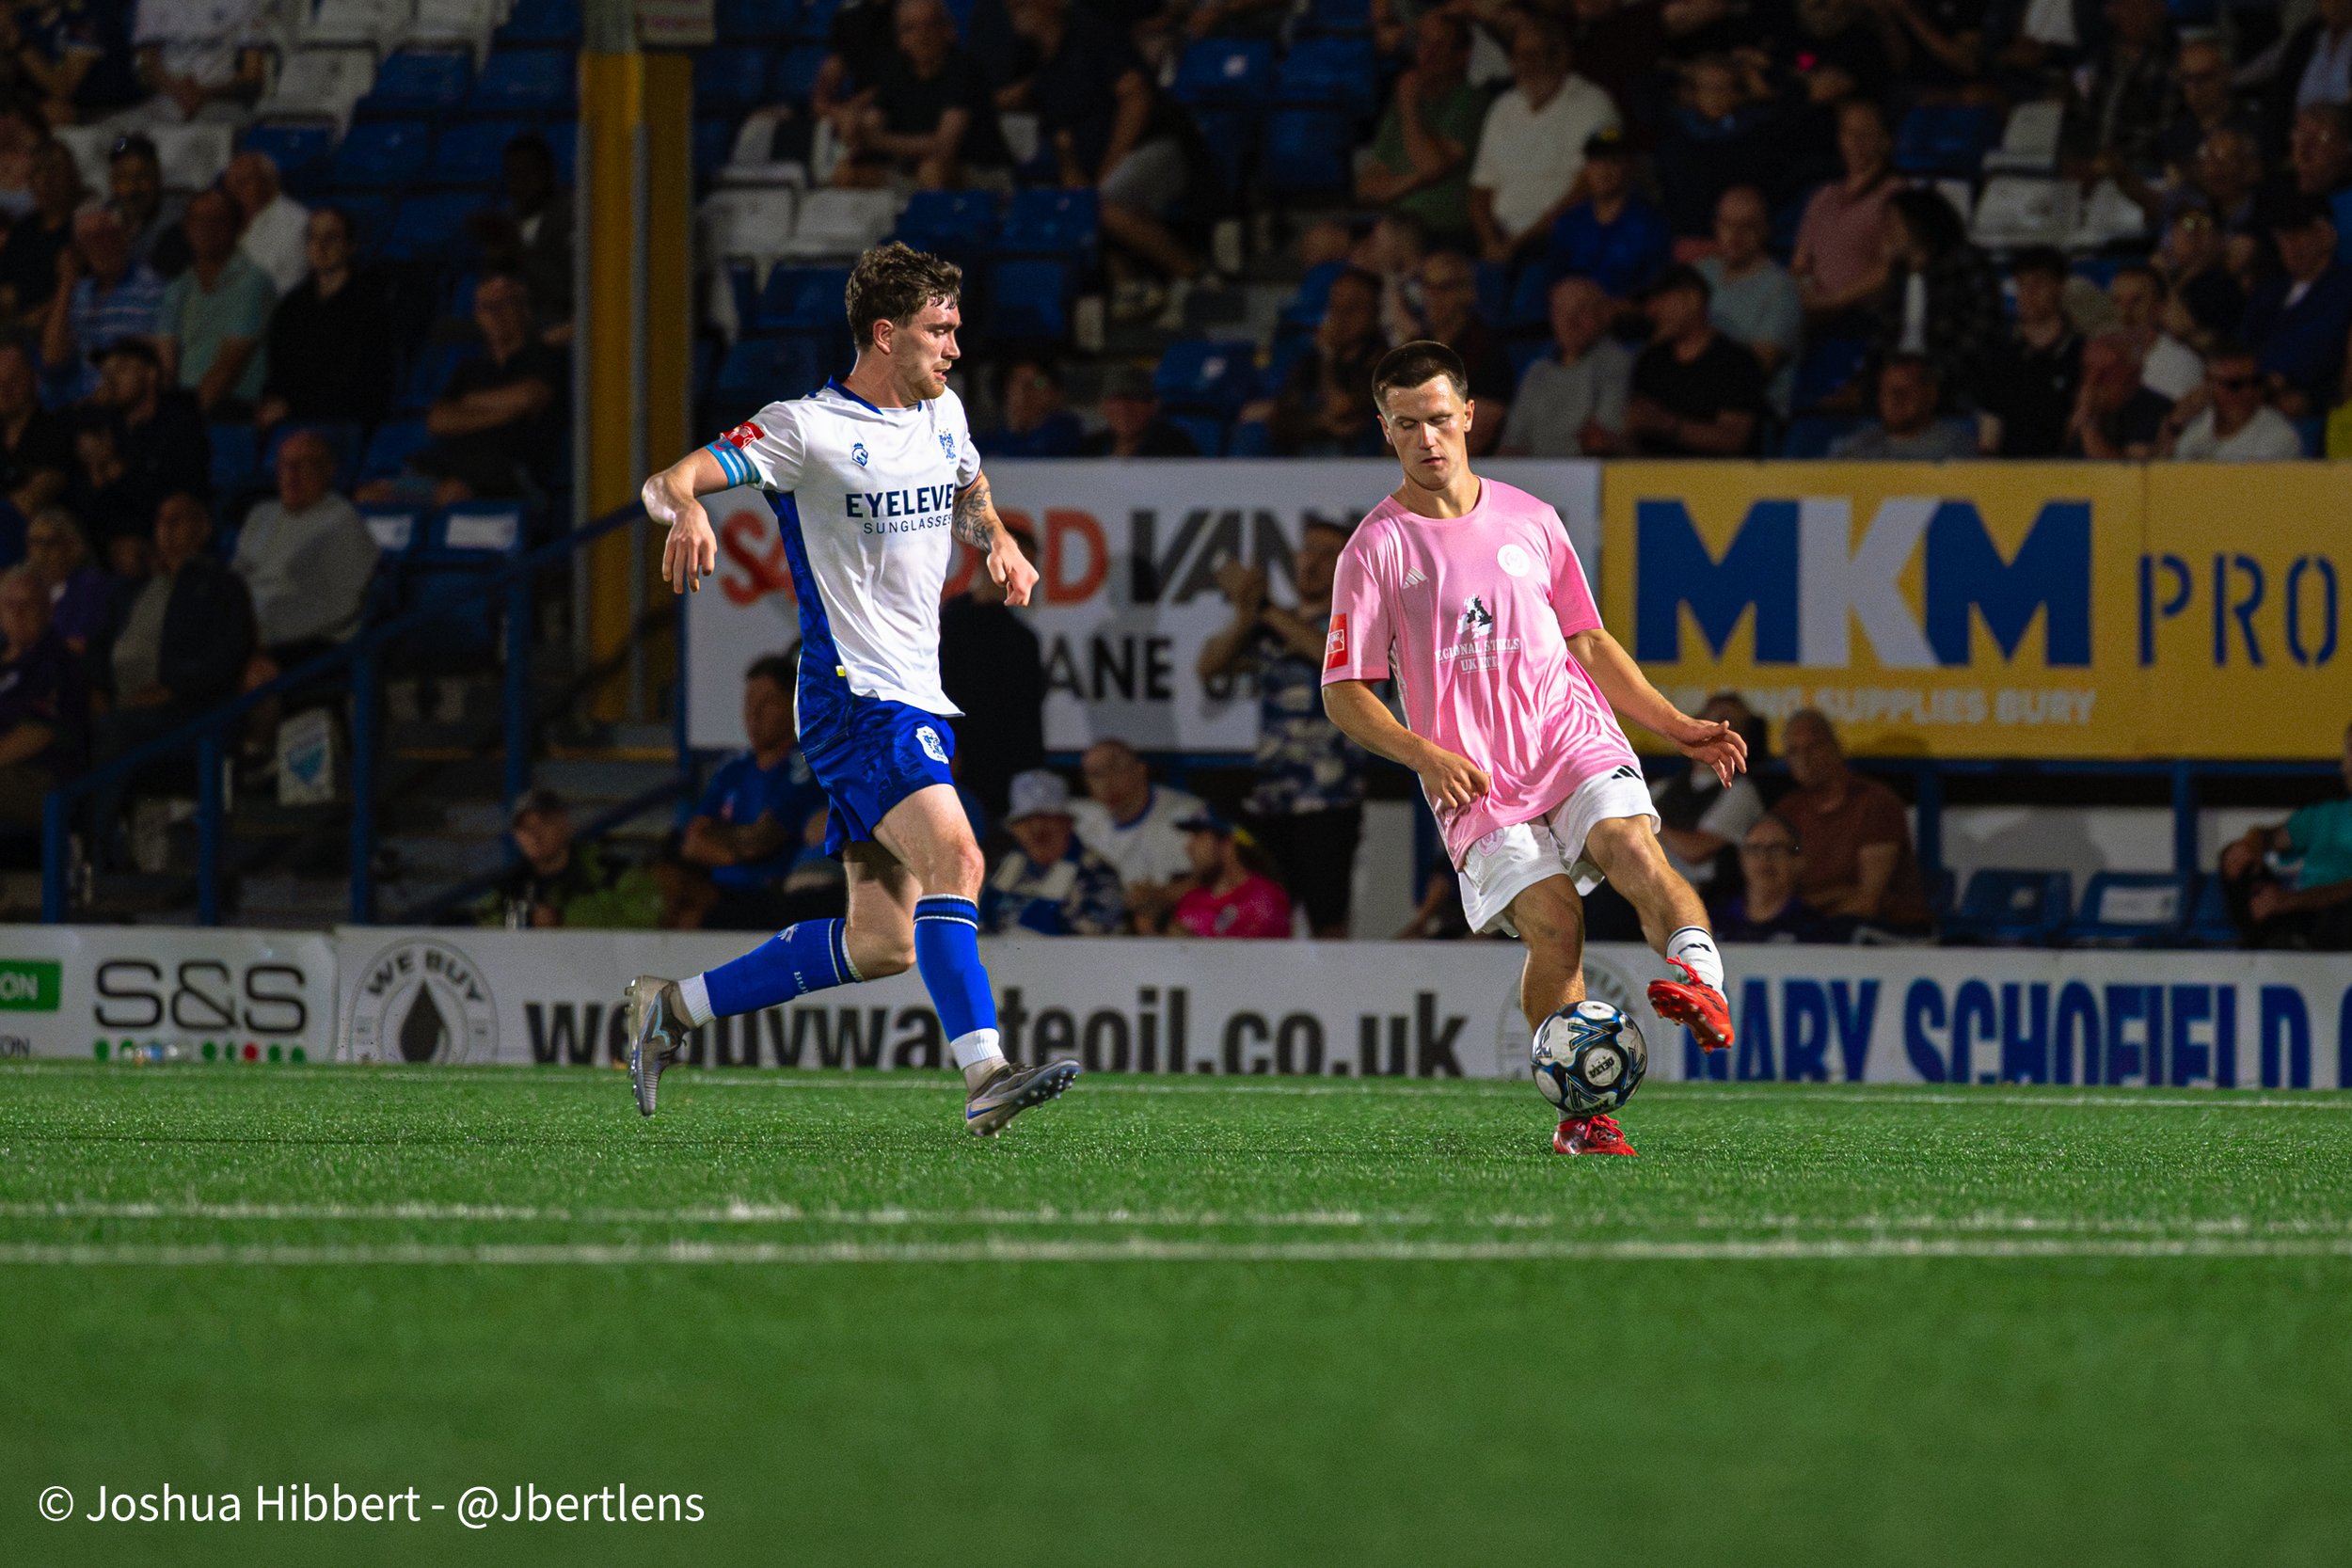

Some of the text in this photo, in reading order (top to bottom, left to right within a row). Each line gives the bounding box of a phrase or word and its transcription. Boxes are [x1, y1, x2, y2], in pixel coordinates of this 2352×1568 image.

[863, 514, 953, 534] SUNGLASSES
[1132, 508, 1366, 608] VAN
[1635, 496, 2092, 670] MKM
[2138, 553, 2339, 669] PRO
[1041, 635, 1173, 701] ANE
[1460, 657, 1477, 672] UK
[1812, 688, 1987, 725] SUPPLIES
[1994, 690, 2098, 725] BURY
[95, 960, 307, 1033] S&S
[367, 949, 414, 996] WE
[1588, 1055, 1615, 1079] DELTA
